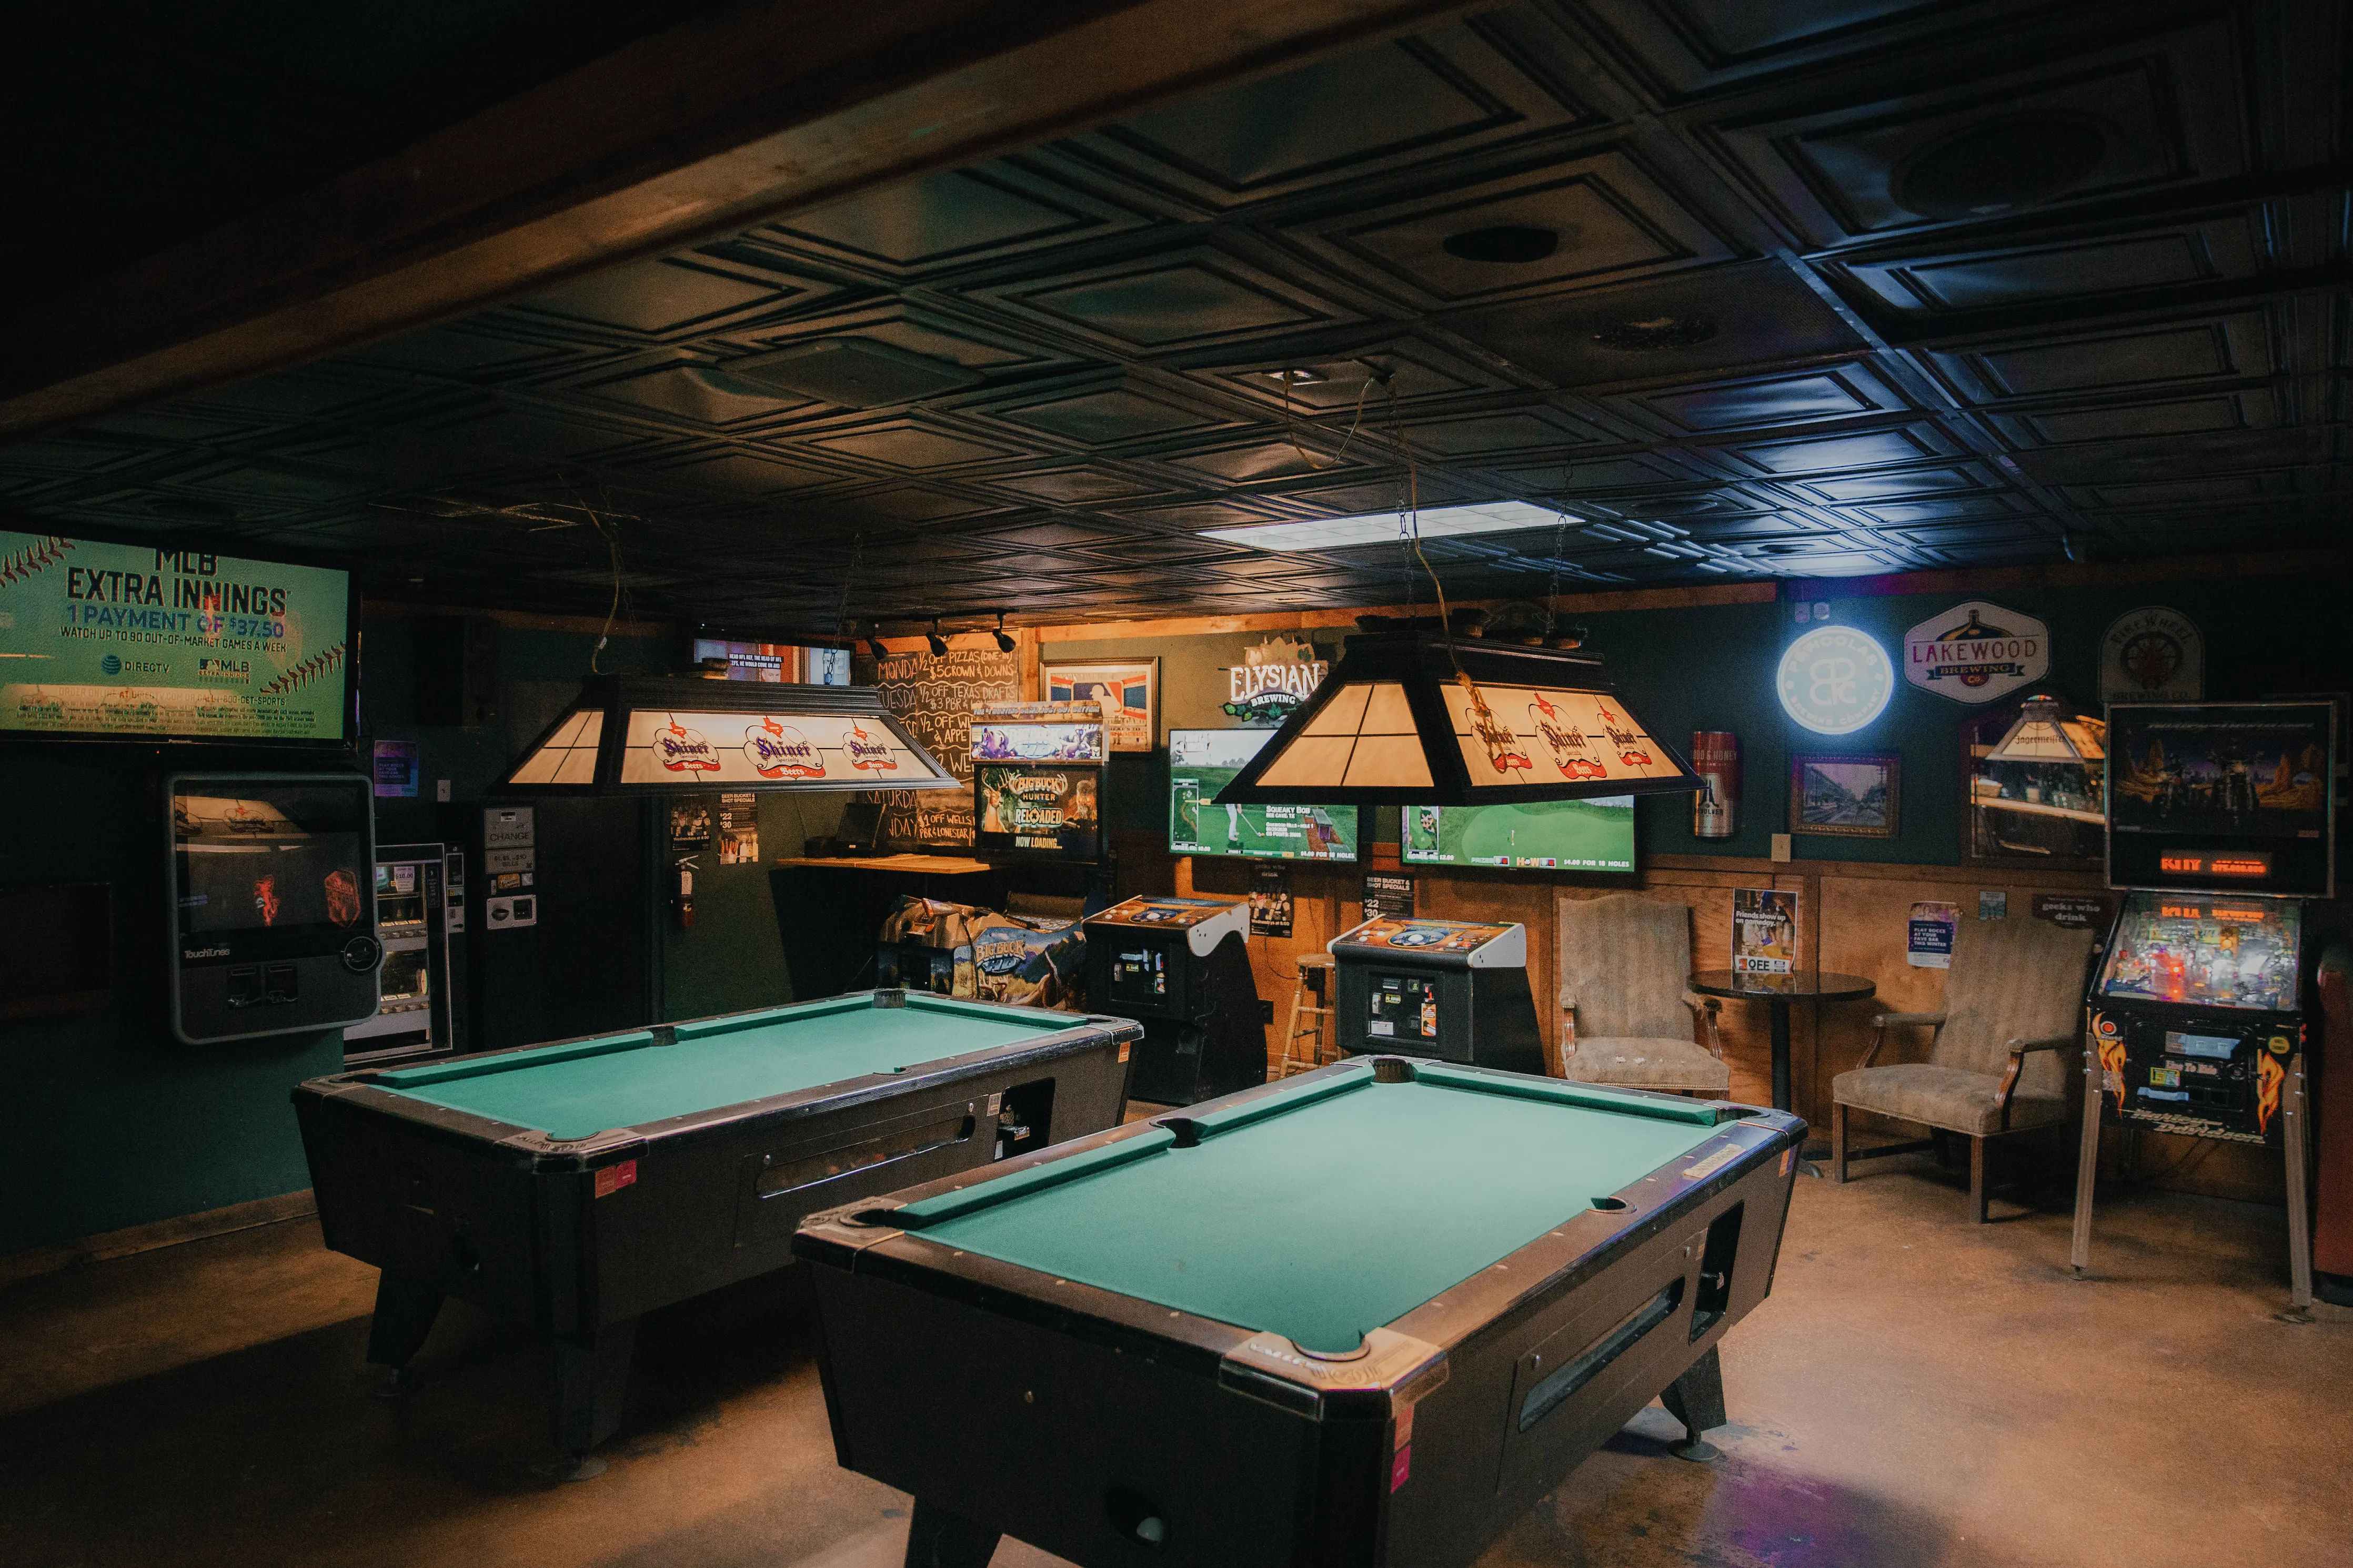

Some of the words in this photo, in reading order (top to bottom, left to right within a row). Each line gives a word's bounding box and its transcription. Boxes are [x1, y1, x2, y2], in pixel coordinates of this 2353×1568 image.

[155, 549, 218, 576] MLB
[67, 566, 165, 606] EXTRA
[173, 578, 287, 617] INNINGS
[67, 604, 77, 623] 1
[84, 605, 190, 631] PAYMENT
[196, 614, 224, 633] OF
[230, 616, 284, 639] $37.50
[59, 626, 96, 639] WATCH
[99, 629, 112, 641] UP
[116, 631, 128, 641] TO
[130, 632, 142, 642] 90
[145, 633, 219, 649] OUT-OF-MARKET
[223, 637, 252, 651] GAMES
[254, 640, 260, 651] A
[263, 642, 287, 653] WEEK
[949, 651, 980, 663] PIZZAS
[981, 650, 1013, 664] (DINE-IN)
[1912, 639, 2037, 663] LAKEWOOD
[124, 661, 169, 673] DIRECTV
[221, 660, 250, 672] MLB
[878, 658, 918, 680] MONDA
[944, 665, 975, 677] CROWN
[984, 664, 1015, 677] DOWNS
[1940, 664, 2010, 674] BREWING
[1230, 663, 1320, 701] ELYSIAN
[120, 690, 129, 699] AT
[185, 692, 196, 702] OR
[878, 689, 916, 709] TUESDA
[932, 685, 948, 697] OFF
[951, 685, 980, 699] TEXAS
[983, 685, 1015, 700] DRAFTS
[930, 697, 943, 710] $3
[946, 697, 961, 710] PBR
[1250, 694, 1296, 707] BREWING
[1839, 689, 1881, 725] COMPANY
[934, 716, 954, 729] OFF
[944, 729, 970, 743] APPE
[1541, 720, 1587, 754] Shiner
[1605, 724, 1637, 749] Shiner
[663, 737, 709, 757] Shiner
[756, 737, 811, 761] Shiner
[850, 740, 888, 758] Shiner
[1629, 754, 1642, 763] Beers
[1713, 750, 1737, 761] HONEY
[779, 767, 805, 776] Beers
[1573, 763, 1593, 775] Beers
[1017, 777, 1034, 793] BIG
[1035, 777, 1062, 793] BUCK
[867, 790, 917, 809] SATURDA
[1022, 793, 1056, 801] HUNTER
[930, 814, 944, 824] OFF
[947, 814, 972, 826] WELLS
[1015, 807, 1062, 825] RELOADED
[490, 832, 530, 842] CHANGE
[920, 827, 933, 838] PBR
[937, 827, 969, 839] LONESTAR
[1015, 836, 1030, 847] NOW
[1031, 837, 1062, 849] LOADING...
[1365, 898, 1379, 908] $22
[2075, 904, 2101, 912] who
[1364, 908, 1378, 917] $30
[1736, 911, 1759, 919] Friends
[2055, 913, 2087, 922] drink
[184, 948, 230, 959] TouchTunes
[976, 943, 994, 963] BIG
[996, 939, 1026, 958] BUCK
